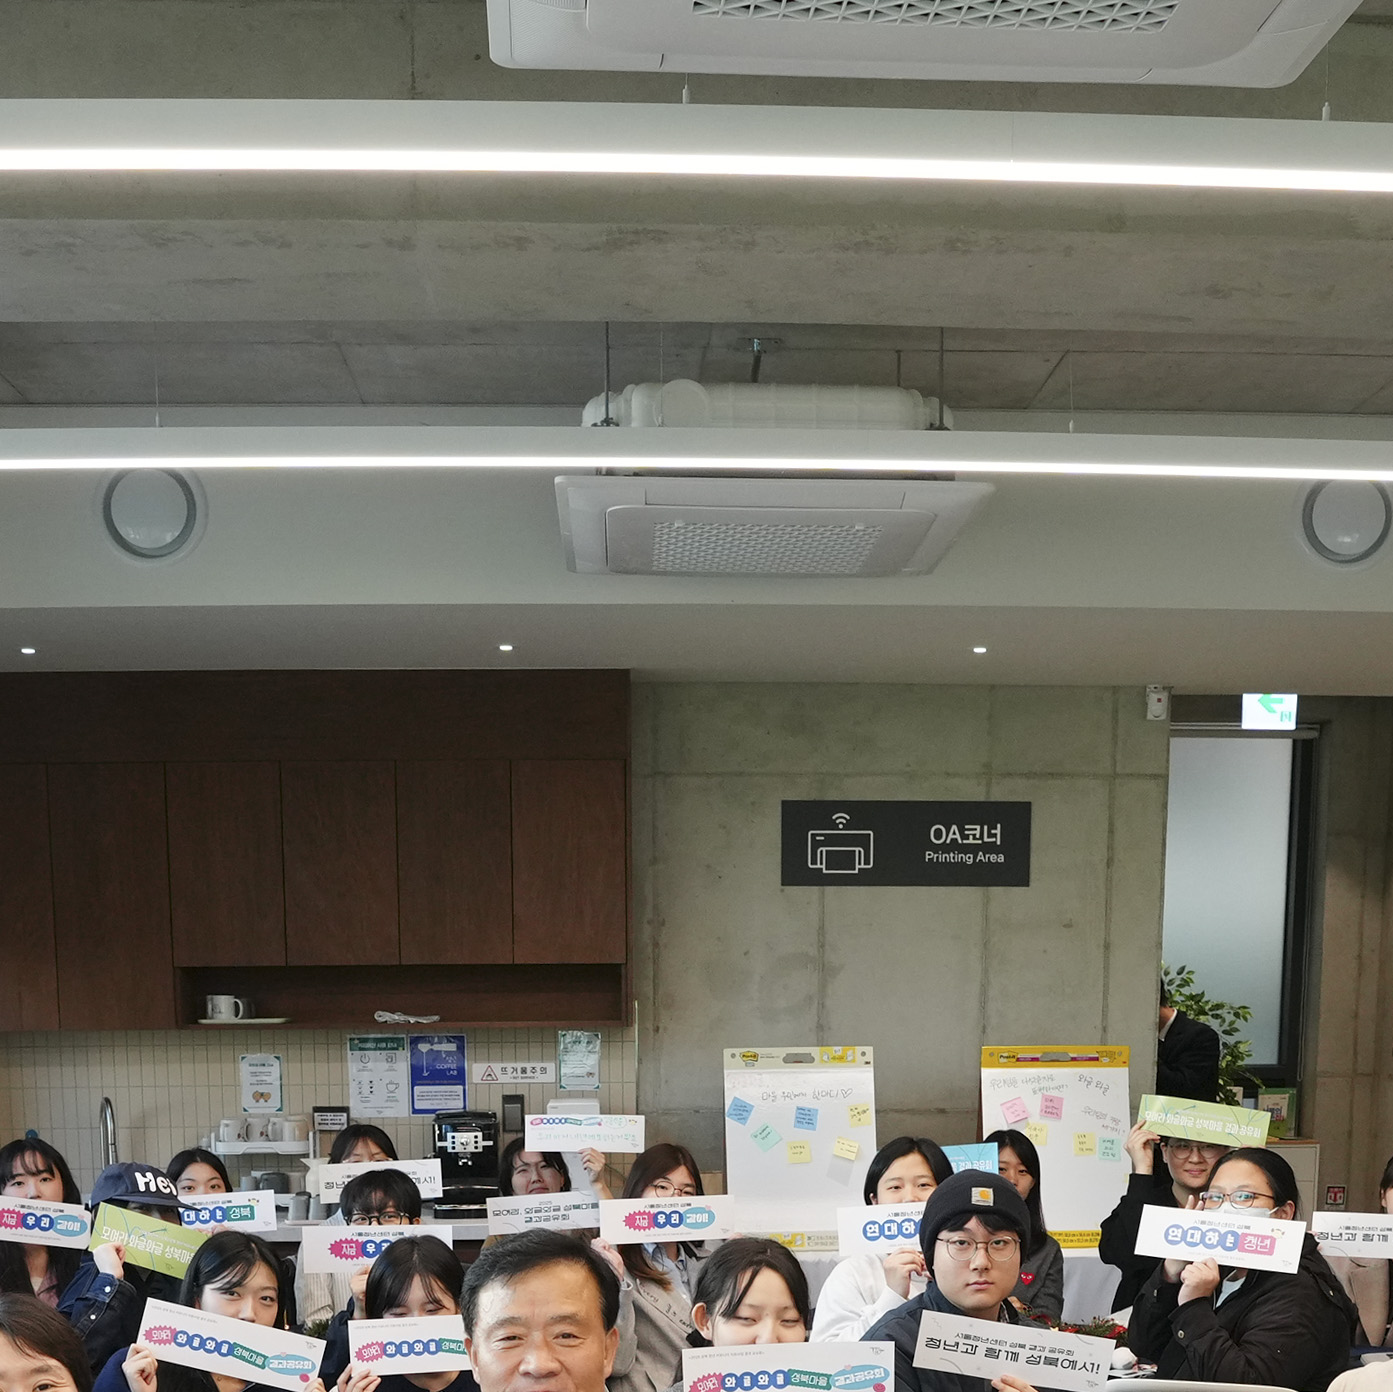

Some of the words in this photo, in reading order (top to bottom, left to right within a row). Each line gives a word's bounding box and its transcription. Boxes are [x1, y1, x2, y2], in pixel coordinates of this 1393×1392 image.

[929, 823, 1002, 846] OA코너
[925, 850, 974, 865] Printing
[976, 851, 1005, 864] Area
[1078, 1074, 1094, 1089] 와글
[1095, 1080, 1110, 1096] 와글
[1145, 1110, 1165, 1122] 모여라
[1166, 1112, 1194, 1127] 와글와글
[1196, 1117, 1223, 1133] 성북마을
[1225, 1122, 1239, 1135] 결과
[1239, 1125, 1261, 1138] 공유회
[134, 1171, 179, 1196] Hey
[229, 1206, 251, 1219] 성북
[524, 1203, 561, 1216] 와글와글
[563, 1200, 600, 1212] 성북마을
[2, 1212, 18, 1226] 지금
[26, 1215, 50, 1228] 우리
[56, 1220, 81, 1232] 같이!
[524, 1213, 570, 1225] 결과공유회
[634, 1215, 649, 1228] 지금
[657, 1213, 680, 1225] 우리
[686, 1212, 709, 1224] 같이!
[866, 1221, 916, 1236] 연대하
[101, 1226, 128, 1246] 모여라
[129, 1235, 164, 1257] 와글와글
[1167, 1227, 1235, 1248] 연대하는
[1243, 1234, 1271, 1252] 청년
[1316, 1231, 1357, 1242] 청년과
[1362, 1233, 1389, 1243] 함께
[341, 1243, 357, 1256] 지금
[151, 1329, 172, 1341] 모여라
[175, 1332, 229, 1354] 와글와글
[233, 1345, 265, 1366] 성북마을
[269, 1358, 313, 1371] 결과공유회
[361, 1345, 381, 1359] 모여라
[386, 1342, 437, 1355] 와글와글
[441, 1340, 467, 1352] 성북마
[954, 1332, 1008, 1347] 서울청년센터
[1009, 1341, 1027, 1350] 성북
[1028, 1344, 1047, 1352] 결과
[1048, 1346, 1075, 1357] 공유회
[925, 1337, 978, 1356] 청년과
[984, 1347, 1019, 1363] 함께
[1025, 1353, 1101, 1375] 성북에서!
[724, 1372, 785, 1389] 와글와글
[791, 1371, 829, 1388] 성북마을
[834, 1367, 886, 1387] 결과공유회
